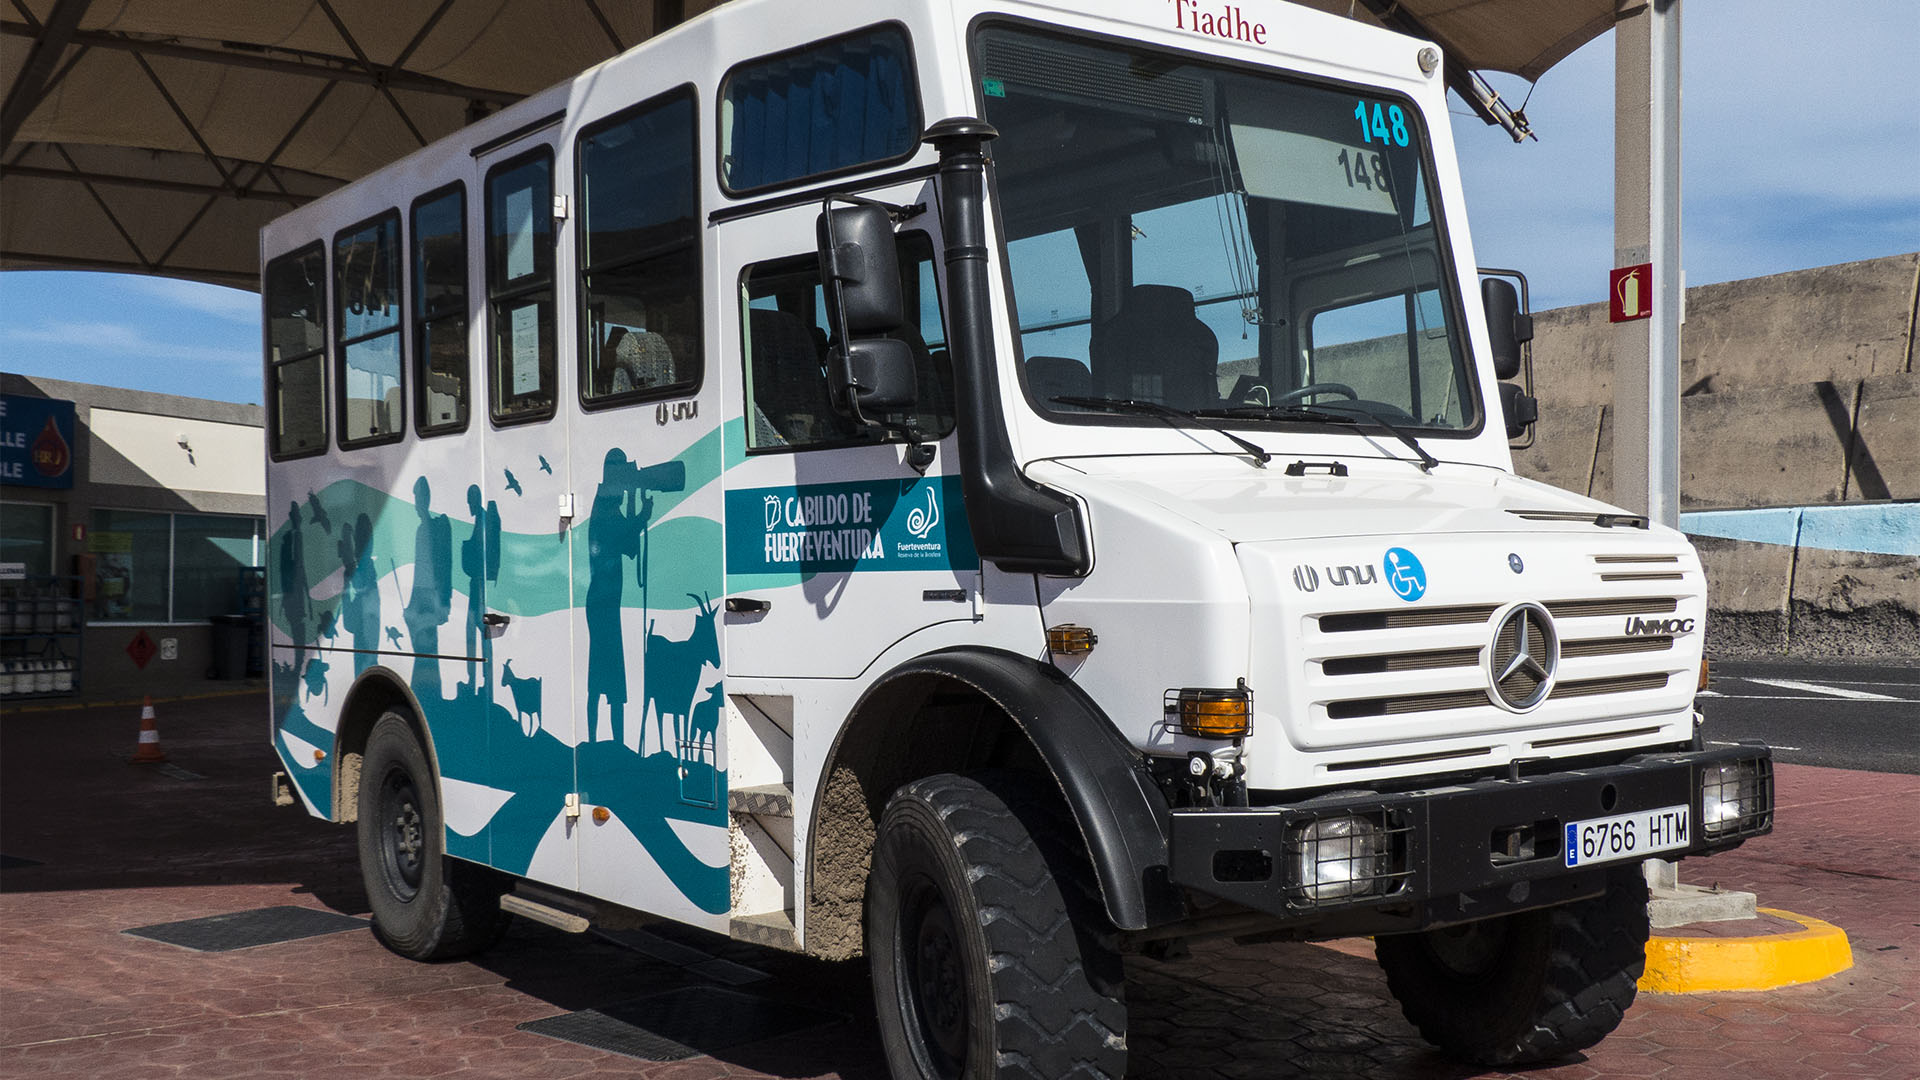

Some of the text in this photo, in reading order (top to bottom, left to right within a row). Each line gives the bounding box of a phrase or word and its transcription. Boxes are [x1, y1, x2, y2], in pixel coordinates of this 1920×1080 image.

[1168, 0, 1267, 45] Tiadhe
[1354, 100, 1409, 147] 148
[1338, 148, 1390, 192] 148
[785, 492, 872, 528] CABILDO DE
[764, 528, 885, 563] FUERTEVENTURA
[897, 542, 941, 551] Fuerteventura
[1569, 849, 1576, 859] E
[1583, 811, 1687, 858] 6766 HTM
